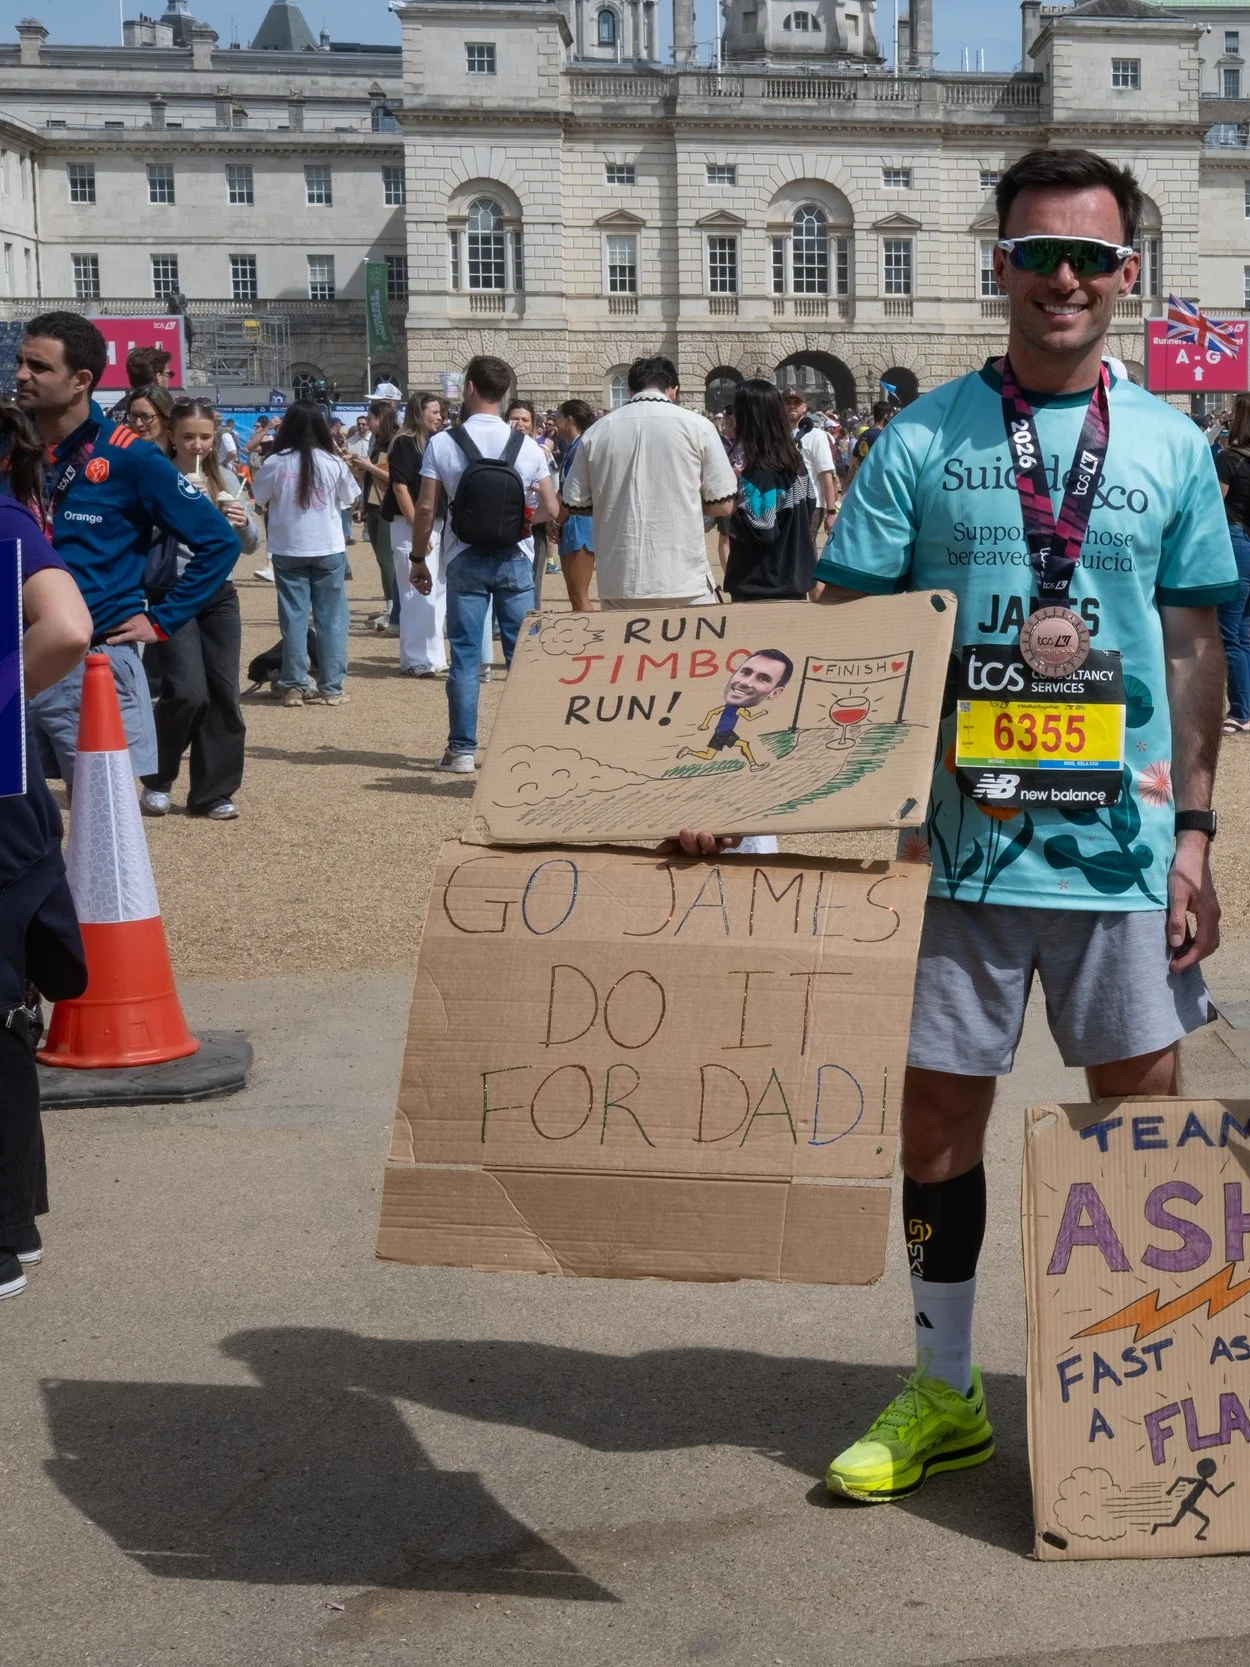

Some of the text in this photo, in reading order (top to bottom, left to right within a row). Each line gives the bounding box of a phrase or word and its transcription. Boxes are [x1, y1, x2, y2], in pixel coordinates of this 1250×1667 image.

[1176, 349, 1190, 364] A
[1206, 350, 1221, 365] G
[1011, 419, 1037, 468] 2026
[1072, 474, 1091, 495] tcs
[64, 511, 103, 524] Orange
[1085, 525, 1134, 547] hose
[624, 616, 727, 644] RUN
[1037, 634, 1054, 646] tcs
[825, 661, 887, 677] FINISH
[968, 654, 1024, 692] tcs
[1031, 682, 1085, 693] SERVICES
[564, 691, 682, 727] RUN!
[993, 712, 1086, 752] 6355
[1020, 788, 1106, 801] new balance
[443, 856, 907, 942] GO JAMES
[539, 964, 853, 1055] DO IT
[480, 1064, 888, 1154] FOR DAD!
[1055, 1337, 1174, 1402] FAST
[1088, 1407, 1114, 1442] A
